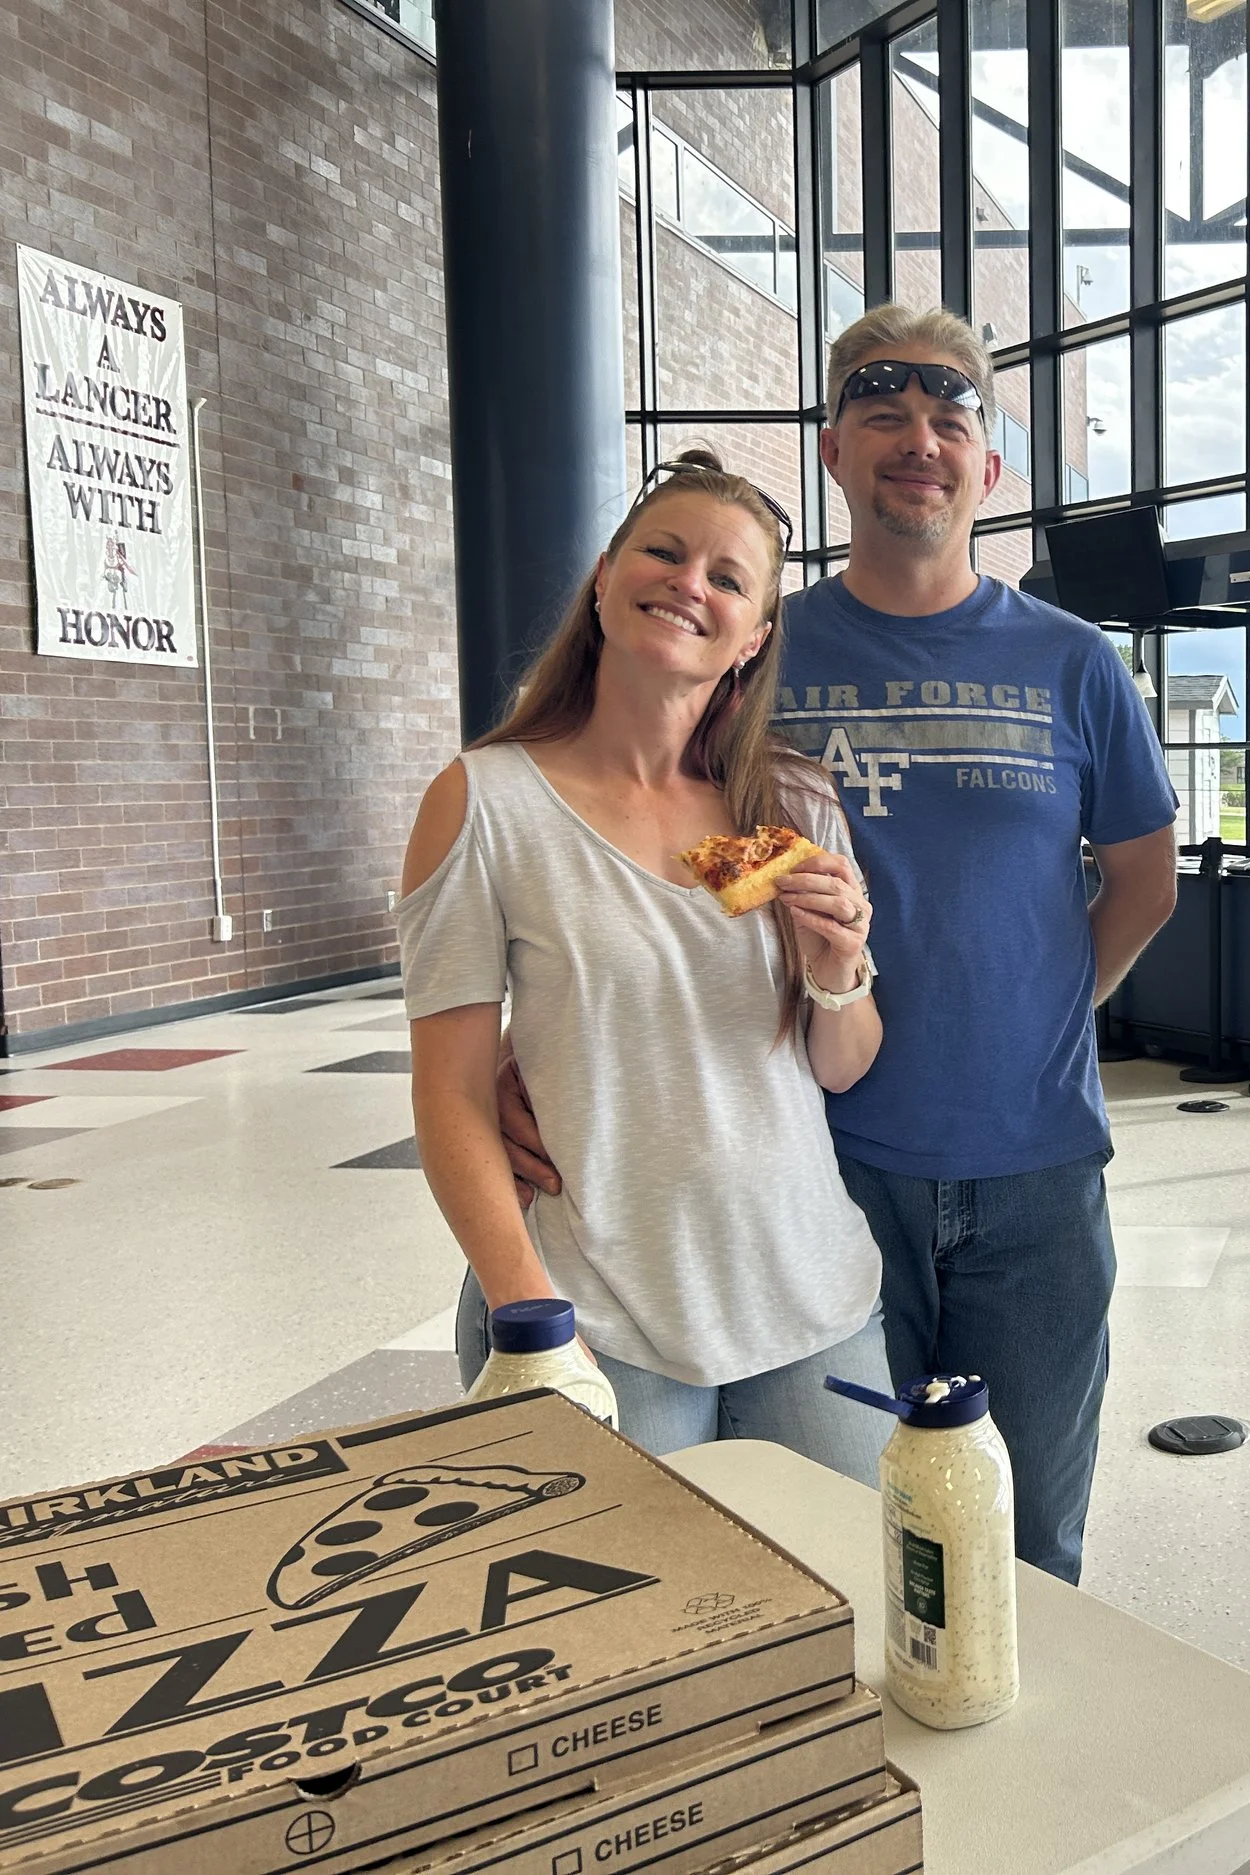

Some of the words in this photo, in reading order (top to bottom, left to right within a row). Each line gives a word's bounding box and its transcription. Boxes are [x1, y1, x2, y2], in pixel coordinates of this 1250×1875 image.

[39, 268, 168, 343] ALWAYS
[96, 333, 121, 374] A
[33, 361, 178, 435] LANCER
[46, 434, 175, 496] ALWAYS
[63, 479, 163, 535] WITH
[57, 606, 179, 655] HONOR
[776, 683, 860, 710] AIR
[884, 679, 1053, 714] FORCE
[956, 767, 1058, 795] FALCONS
[0, 1447, 320, 1530] IRKLAND
[0, 1648, 556, 1830] COSTCO
[227, 1725, 390, 1783] FOOD
[401, 1663, 574, 1728] COURT
[551, 1703, 663, 1758] CHEESE
[594, 1803, 705, 1863] CHEESE
